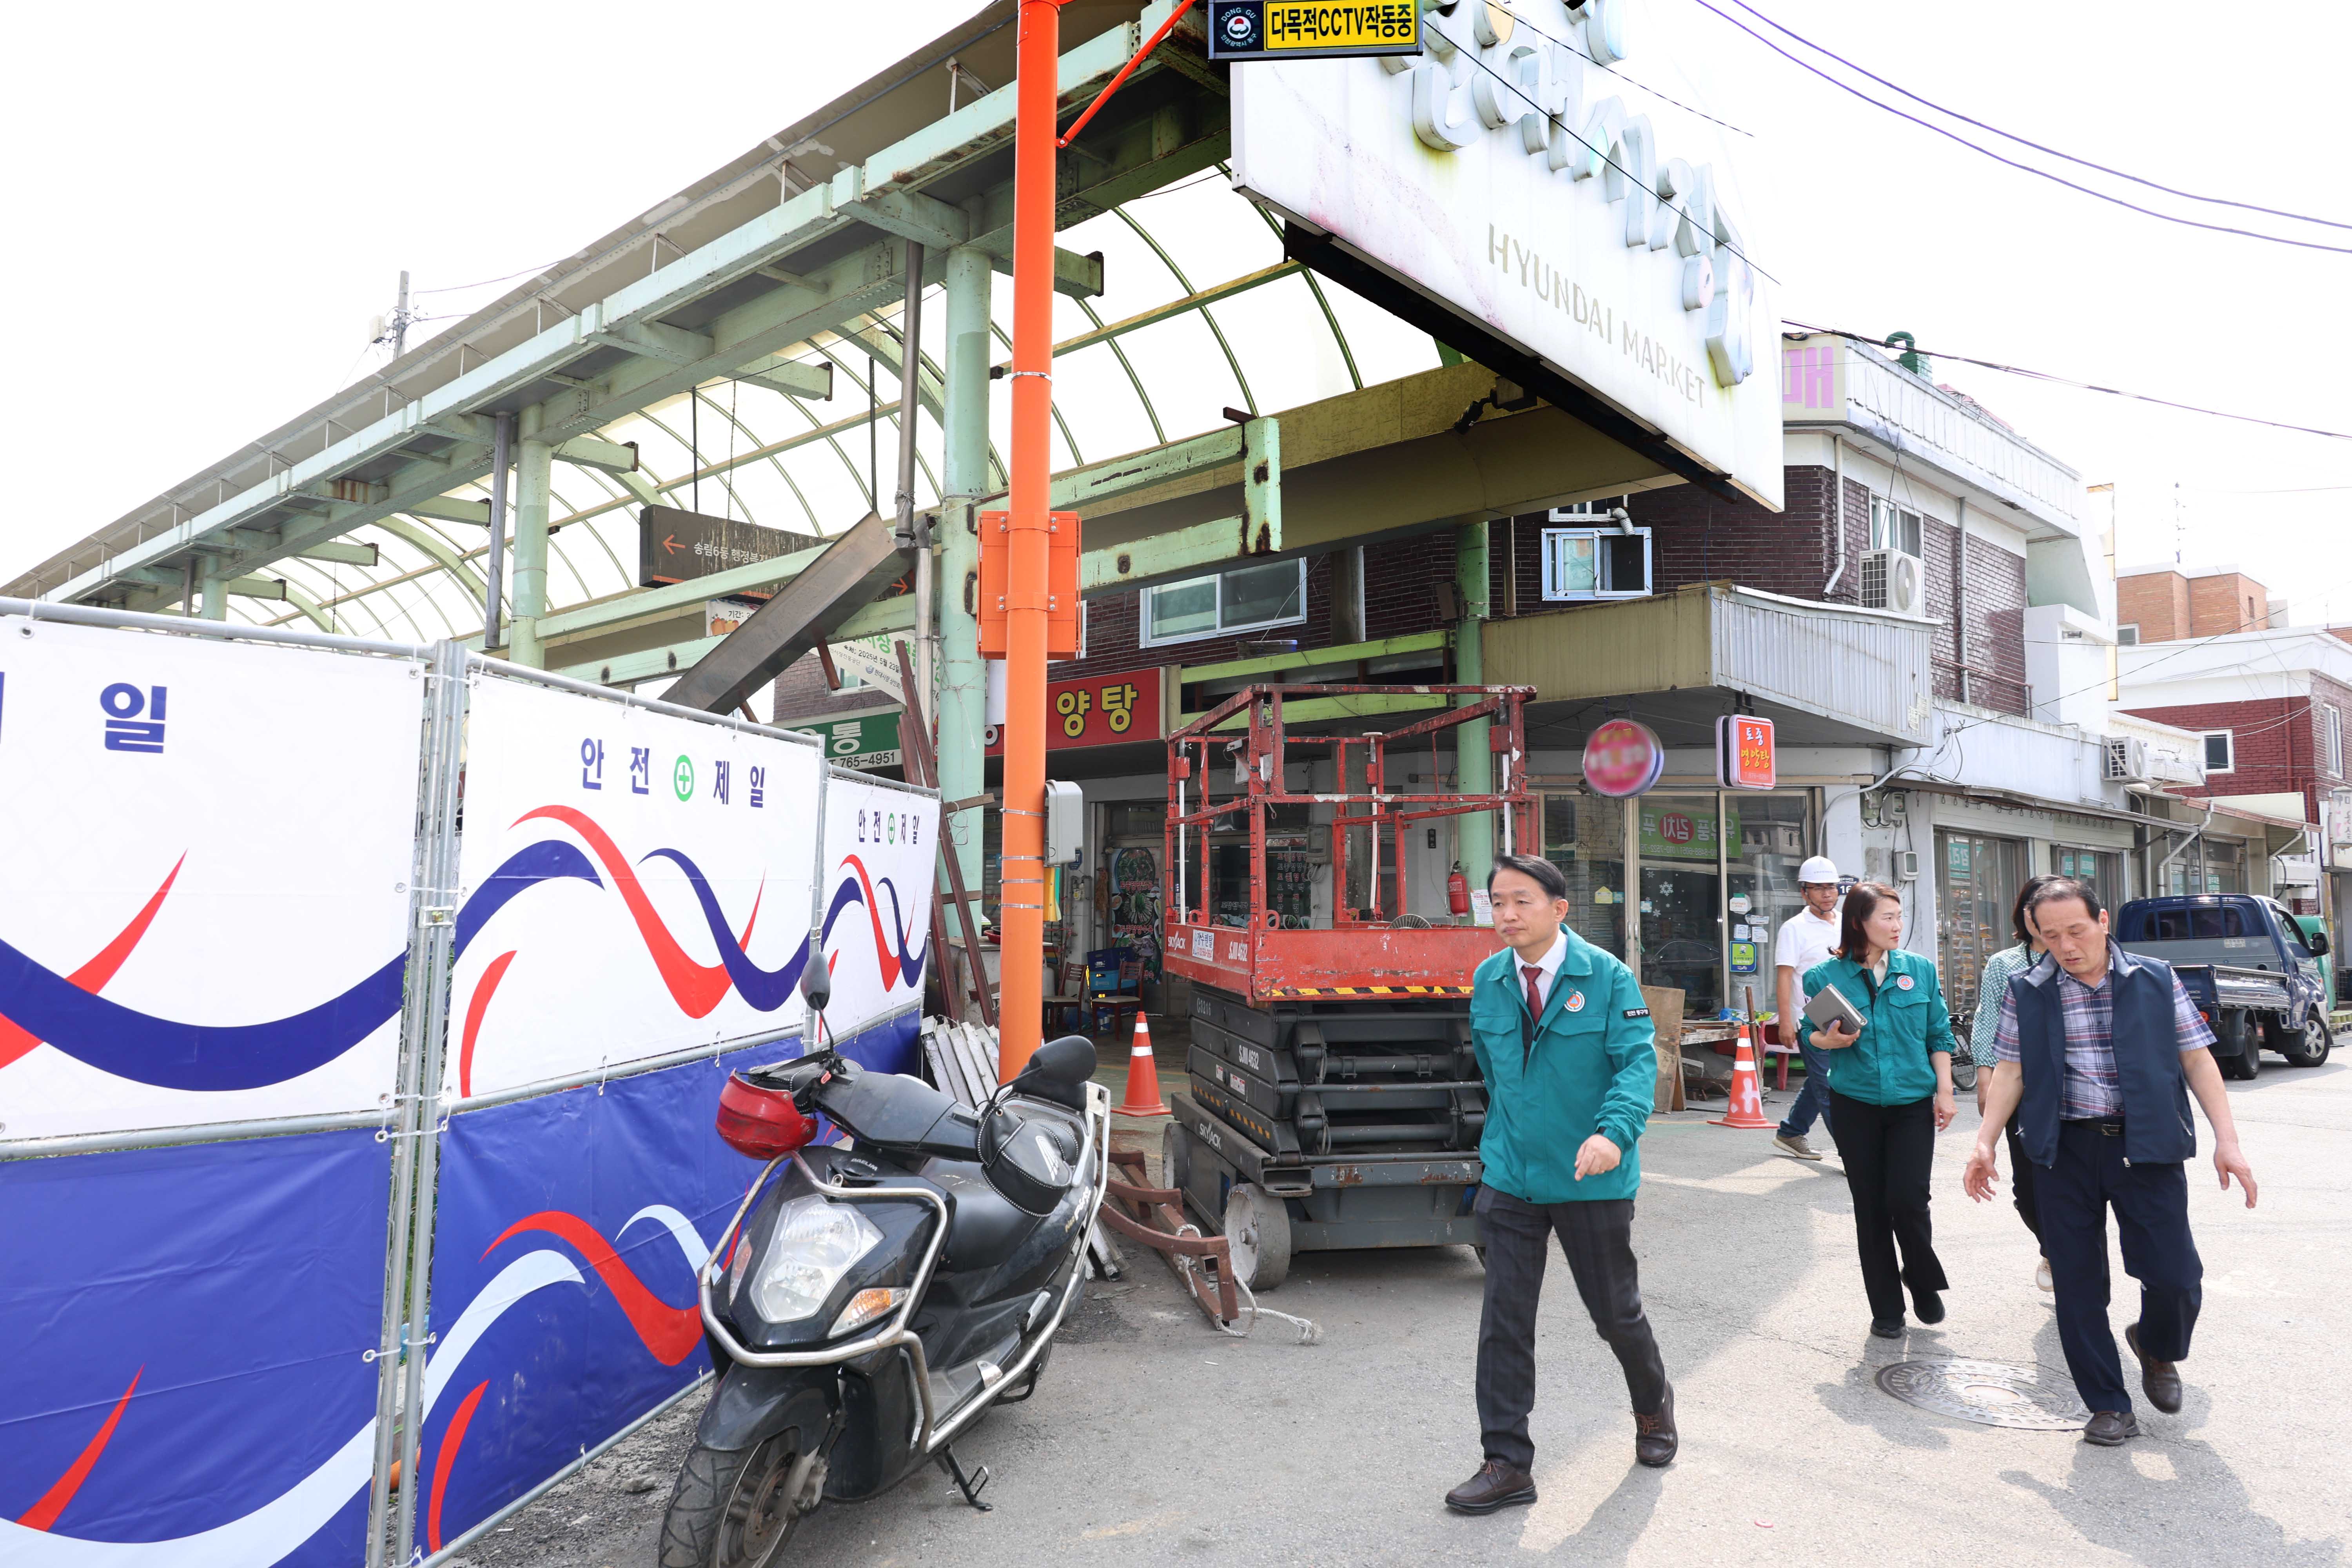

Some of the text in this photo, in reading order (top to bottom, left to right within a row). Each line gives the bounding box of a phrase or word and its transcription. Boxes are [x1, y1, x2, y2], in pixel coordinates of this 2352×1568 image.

[1221, 7, 1256, 21] DONG GU
[1272, 4, 1412, 41] 다목적CCTV작동중
[1221, 34, 1247, 47] 인천광역시
[1489, 222, 1706, 408] HYUNDAI MARKET
[693, 542, 775, 563] 송림6동 행정복지
[728, 610, 744, 619] 기간:
[858, 650, 878, 663] 2025년
[879, 657, 888, 667] 5월
[875, 669, 890, 682] 현대시장
[1746, 727, 1764, 746] 토종
[840, 751, 895, 768] 765-4951
[1741, 748, 1770, 769] 영양탕
[1277, 863, 1305, 872] 토종영양
[1168, 931, 1185, 951] SKYJACK
[1197, 997, 1211, 1016] C3216
[1200, 1122, 1221, 1150] SKYJACK
[851, 1158, 878, 1171] DAELIM
